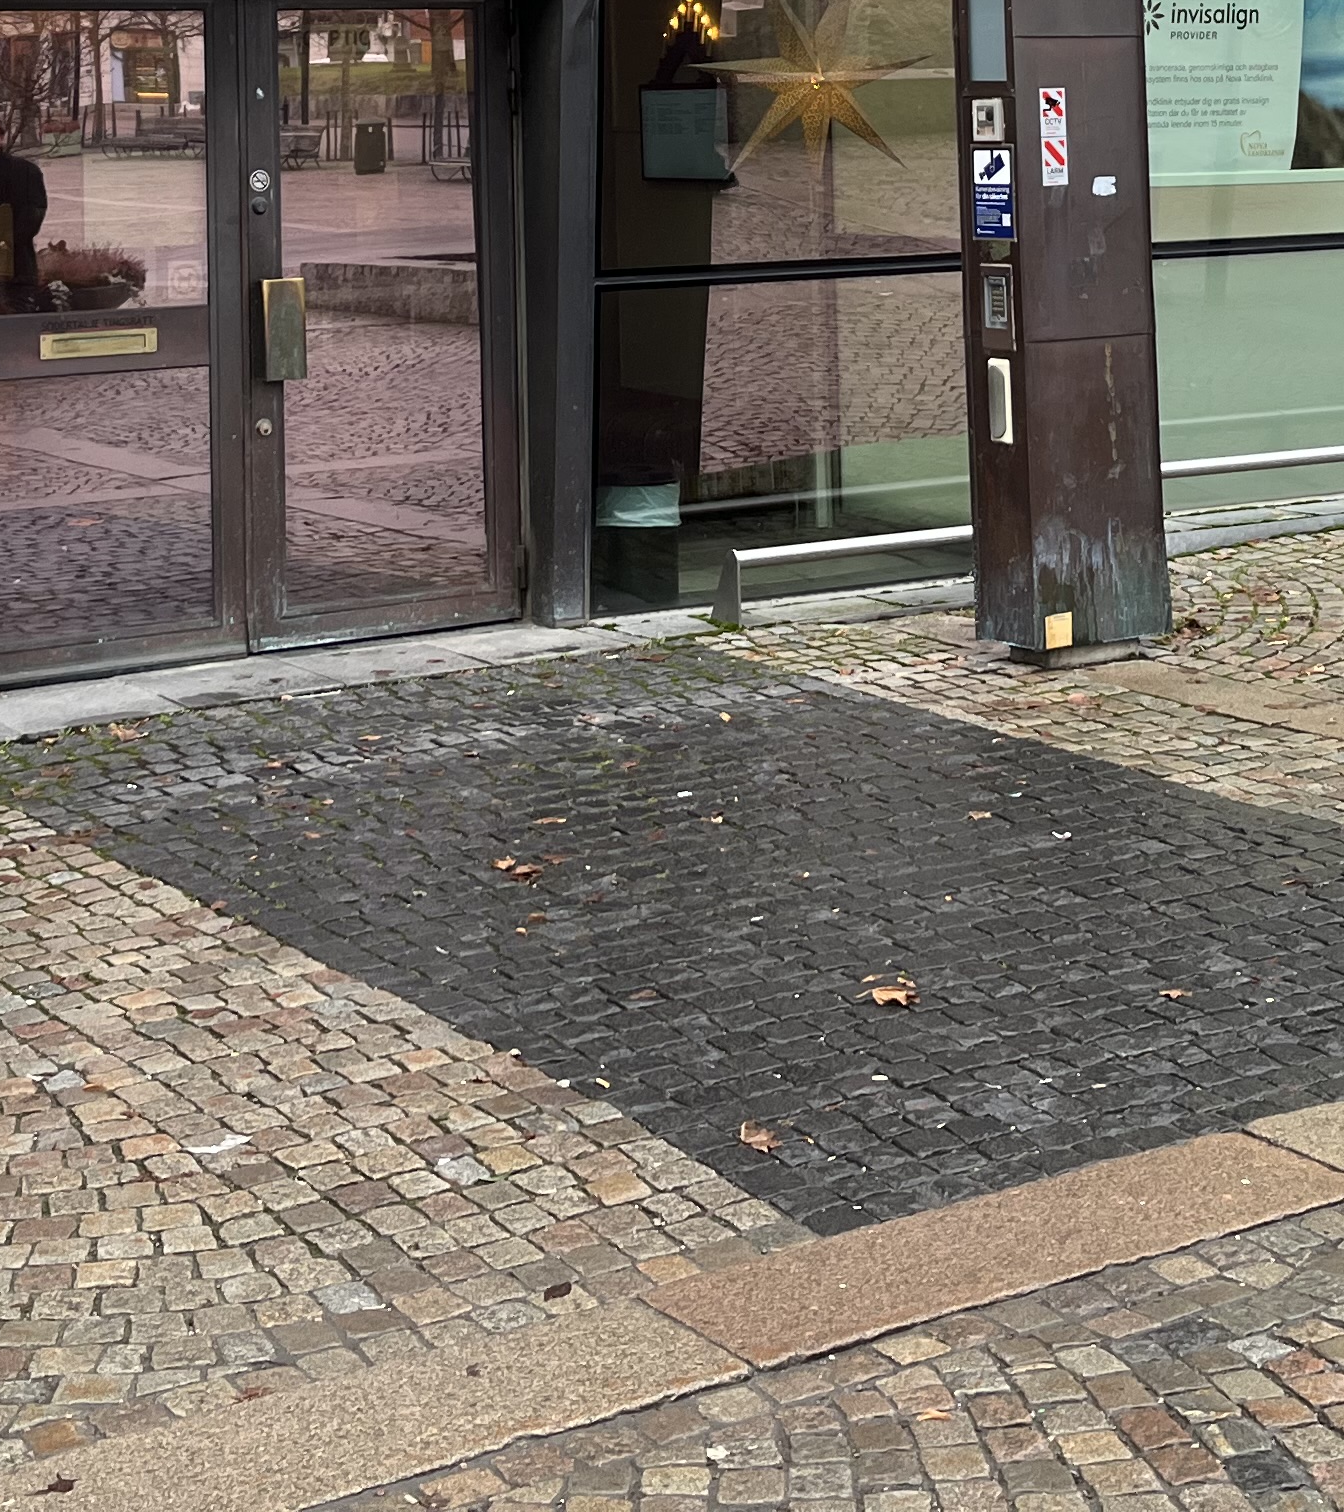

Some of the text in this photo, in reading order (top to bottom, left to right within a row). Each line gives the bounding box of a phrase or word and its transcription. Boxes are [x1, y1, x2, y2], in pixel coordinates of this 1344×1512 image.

[1170, 3, 1260, 30] invisalign
[1170, 31, 1218, 40] PROVIDER
[1045, 118, 1063, 126] CCTV
